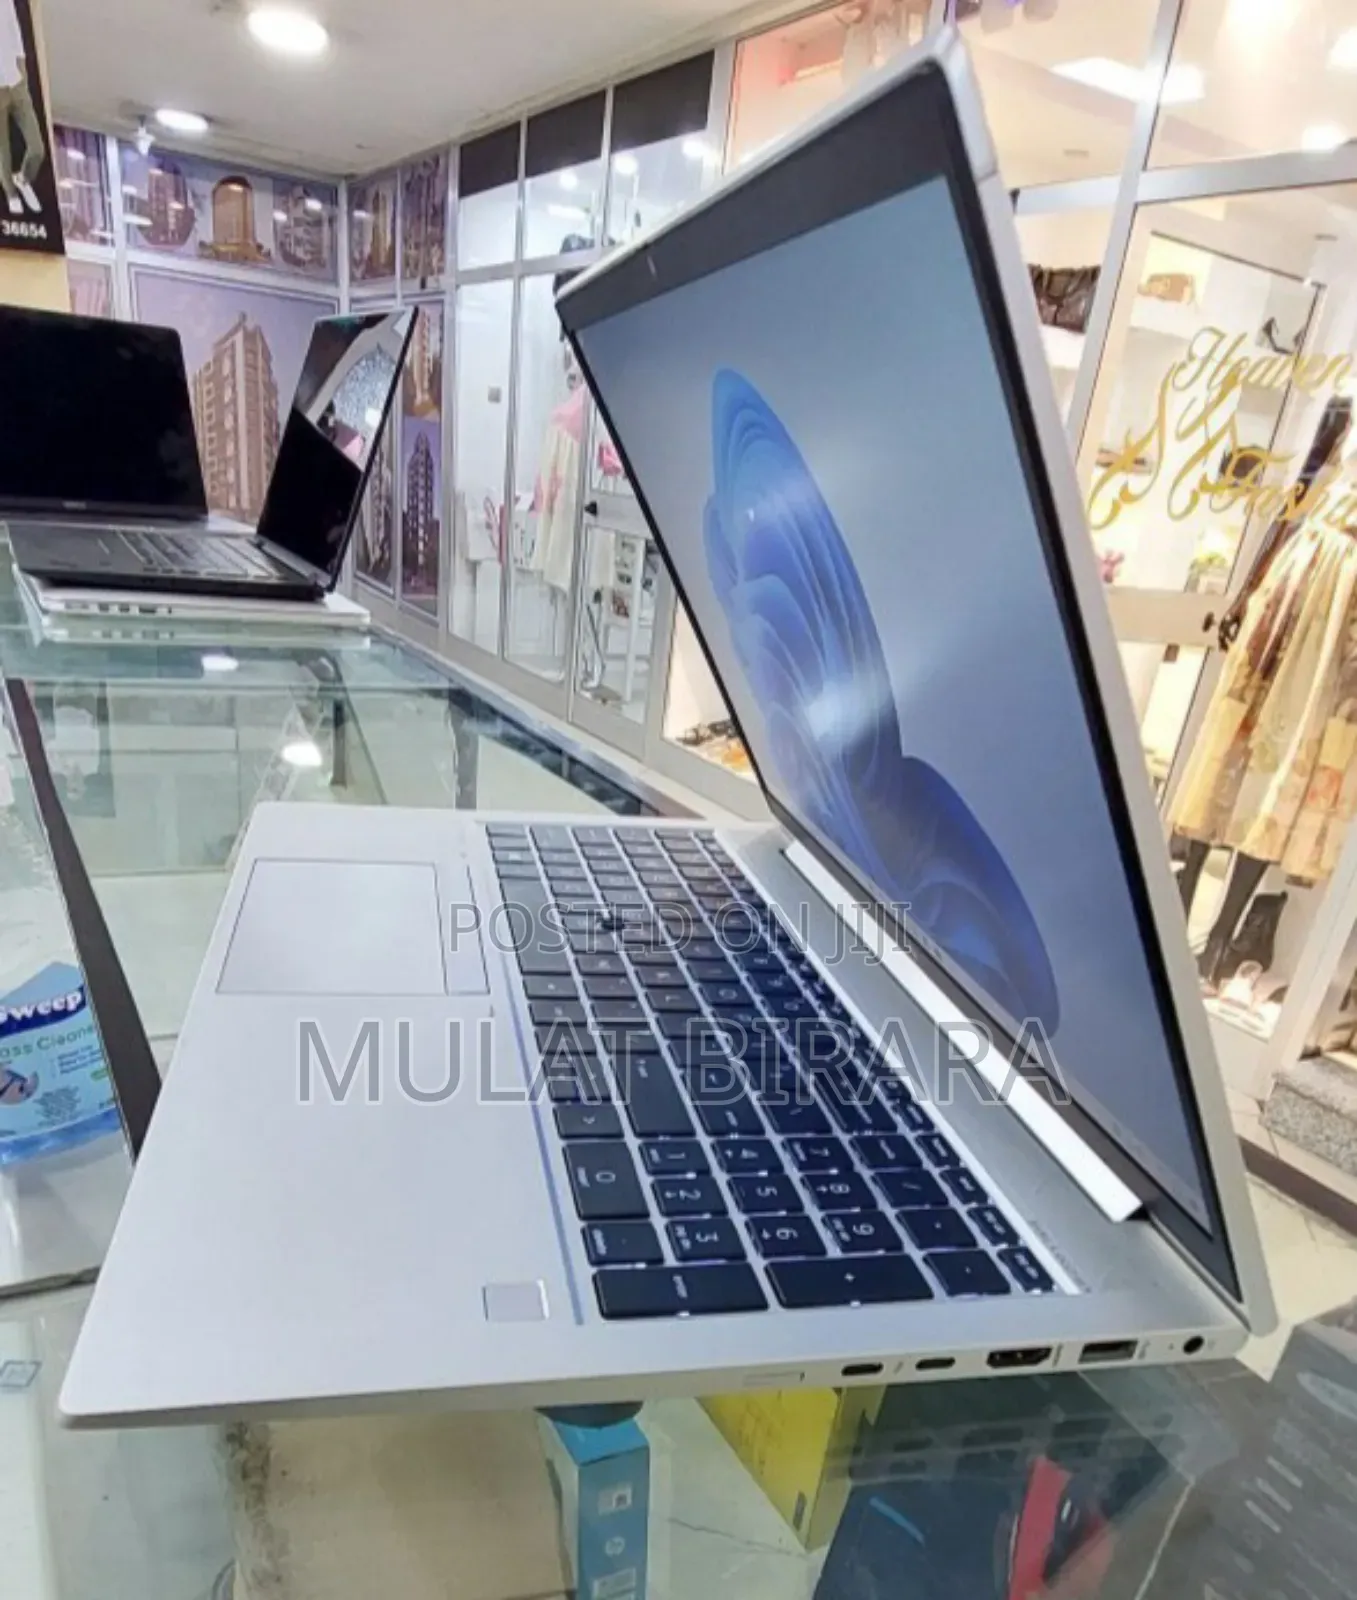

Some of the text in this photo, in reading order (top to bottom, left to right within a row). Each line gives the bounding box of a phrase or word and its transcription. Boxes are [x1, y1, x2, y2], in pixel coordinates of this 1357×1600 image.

[755, 1185, 778, 1198] 5
[829, 1183, 850, 1195] 8
[775, 1226, 799, 1241] 6
[852, 1222, 875, 1237] 9
